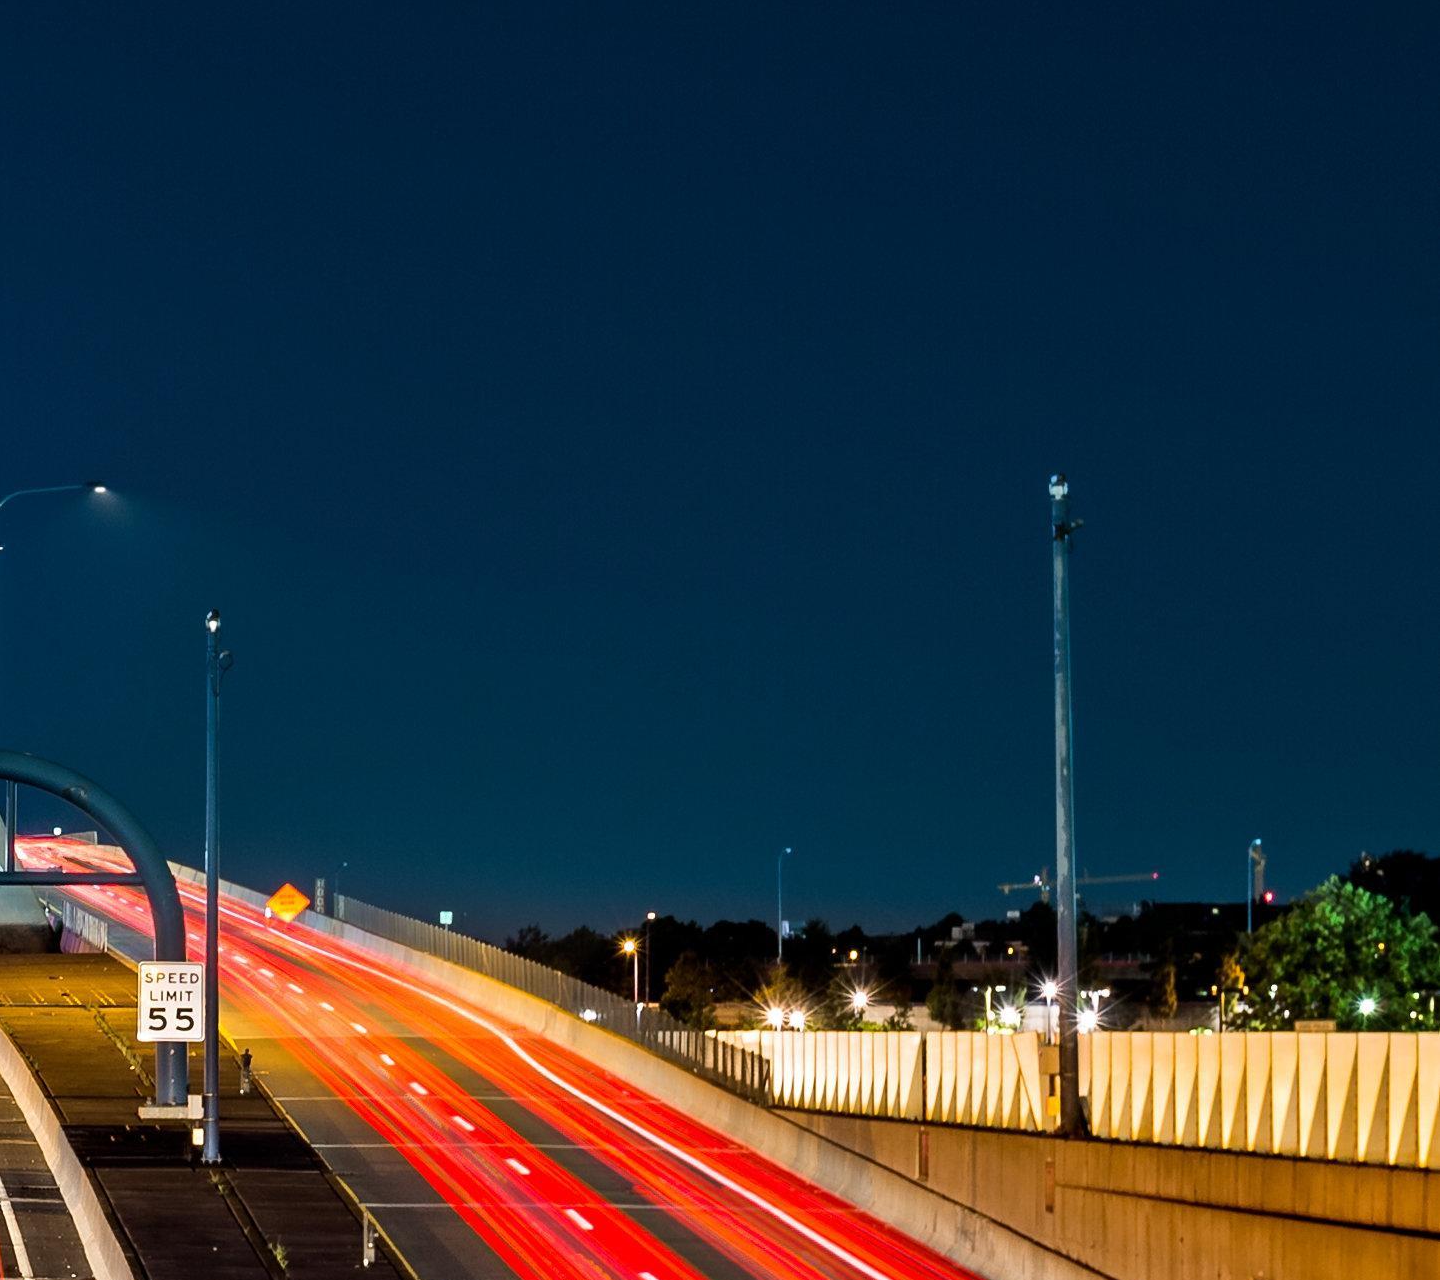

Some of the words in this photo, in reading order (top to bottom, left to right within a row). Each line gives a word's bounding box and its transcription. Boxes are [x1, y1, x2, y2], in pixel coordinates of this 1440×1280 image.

[145, 973, 199, 984] SPEED
[150, 991, 193, 1001] LIMIT
[149, 1008, 194, 1031] 55
